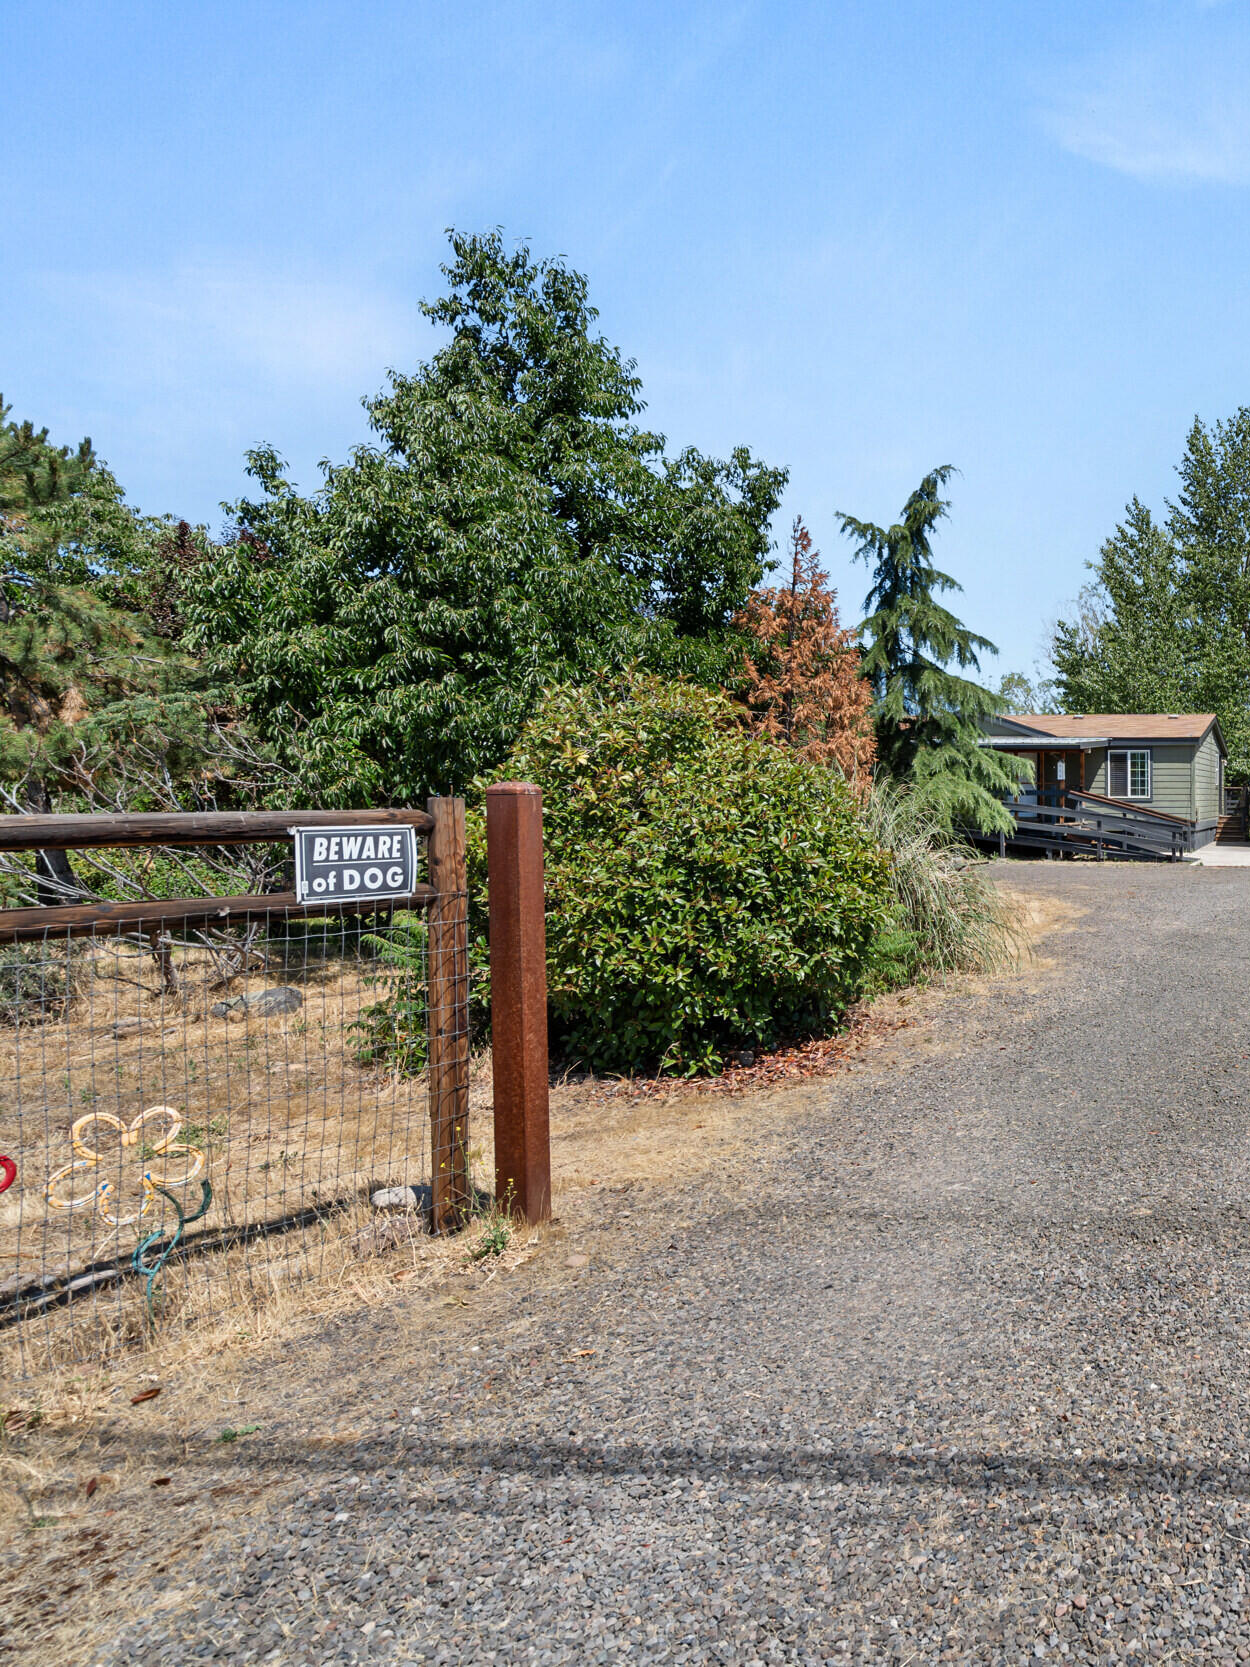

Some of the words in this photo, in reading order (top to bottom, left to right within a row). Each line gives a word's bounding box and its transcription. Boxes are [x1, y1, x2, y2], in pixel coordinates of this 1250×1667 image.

[313, 835, 402, 861] BEWARE
[313, 871, 336, 892] of
[343, 867, 403, 890] DOG
